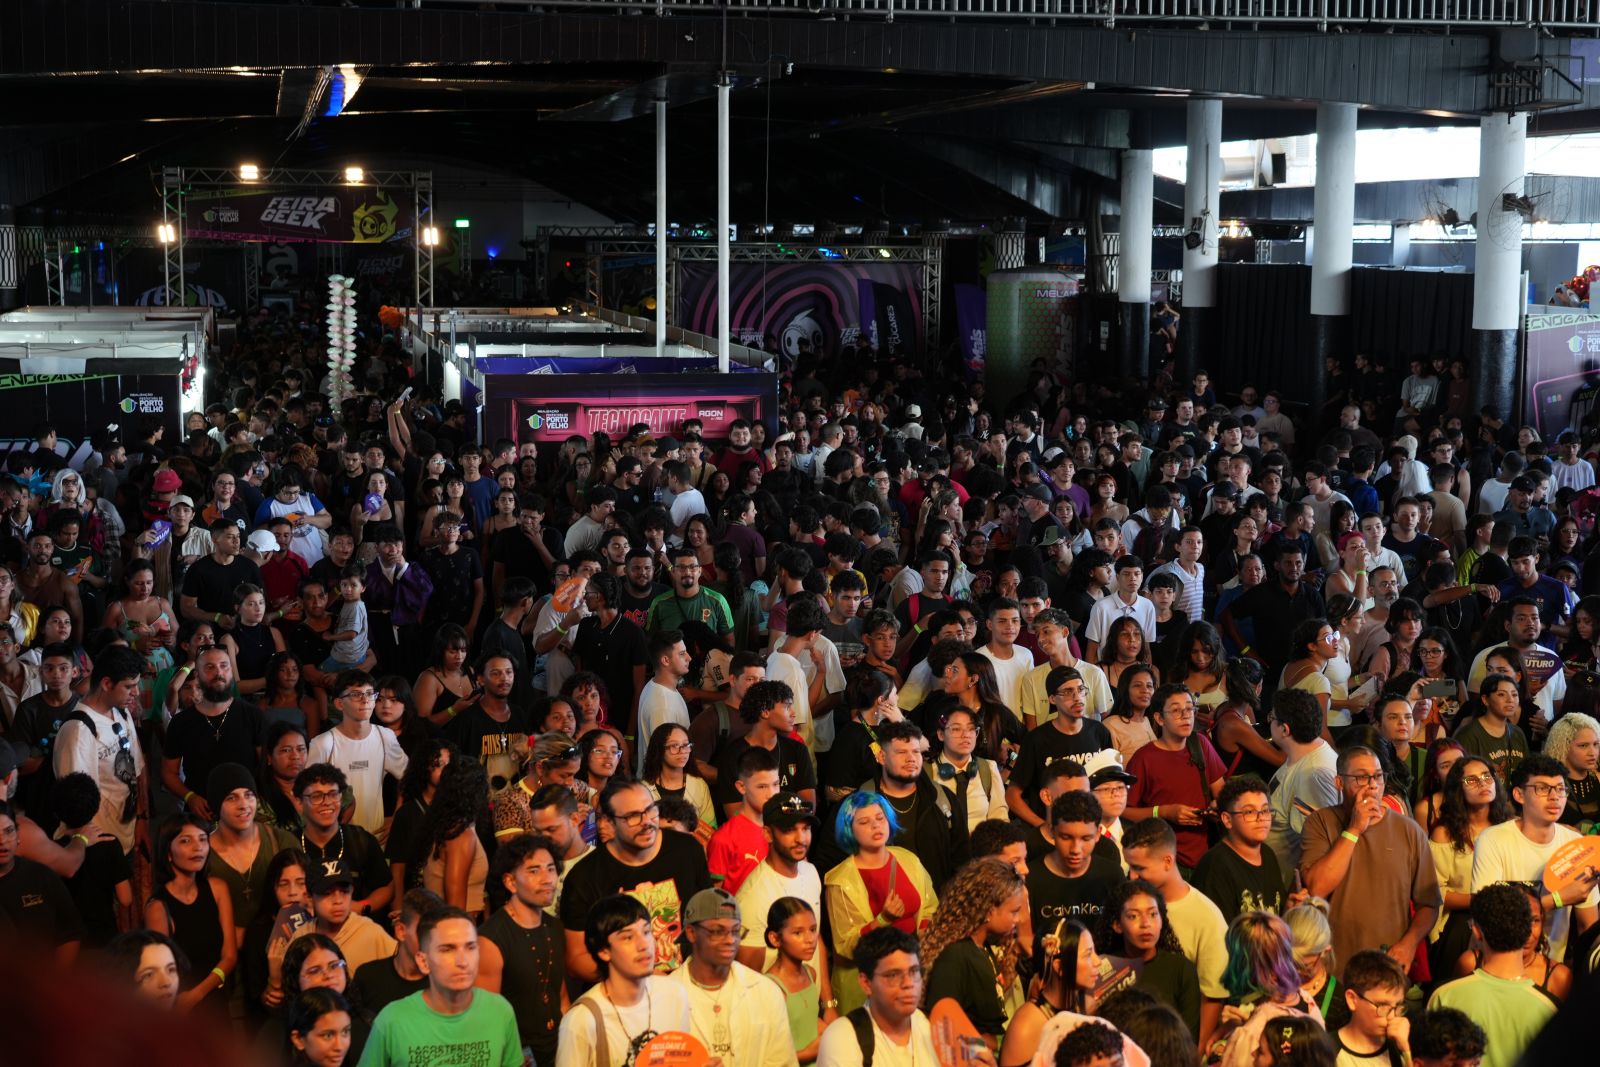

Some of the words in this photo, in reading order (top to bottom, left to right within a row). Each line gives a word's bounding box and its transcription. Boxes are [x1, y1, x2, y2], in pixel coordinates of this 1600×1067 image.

[266, 196, 336, 213] FEIRA
[260, 208, 327, 229] GEEK
[1525, 660, 1555, 668] UTURO
[482, 734, 502, 755] GUNS
